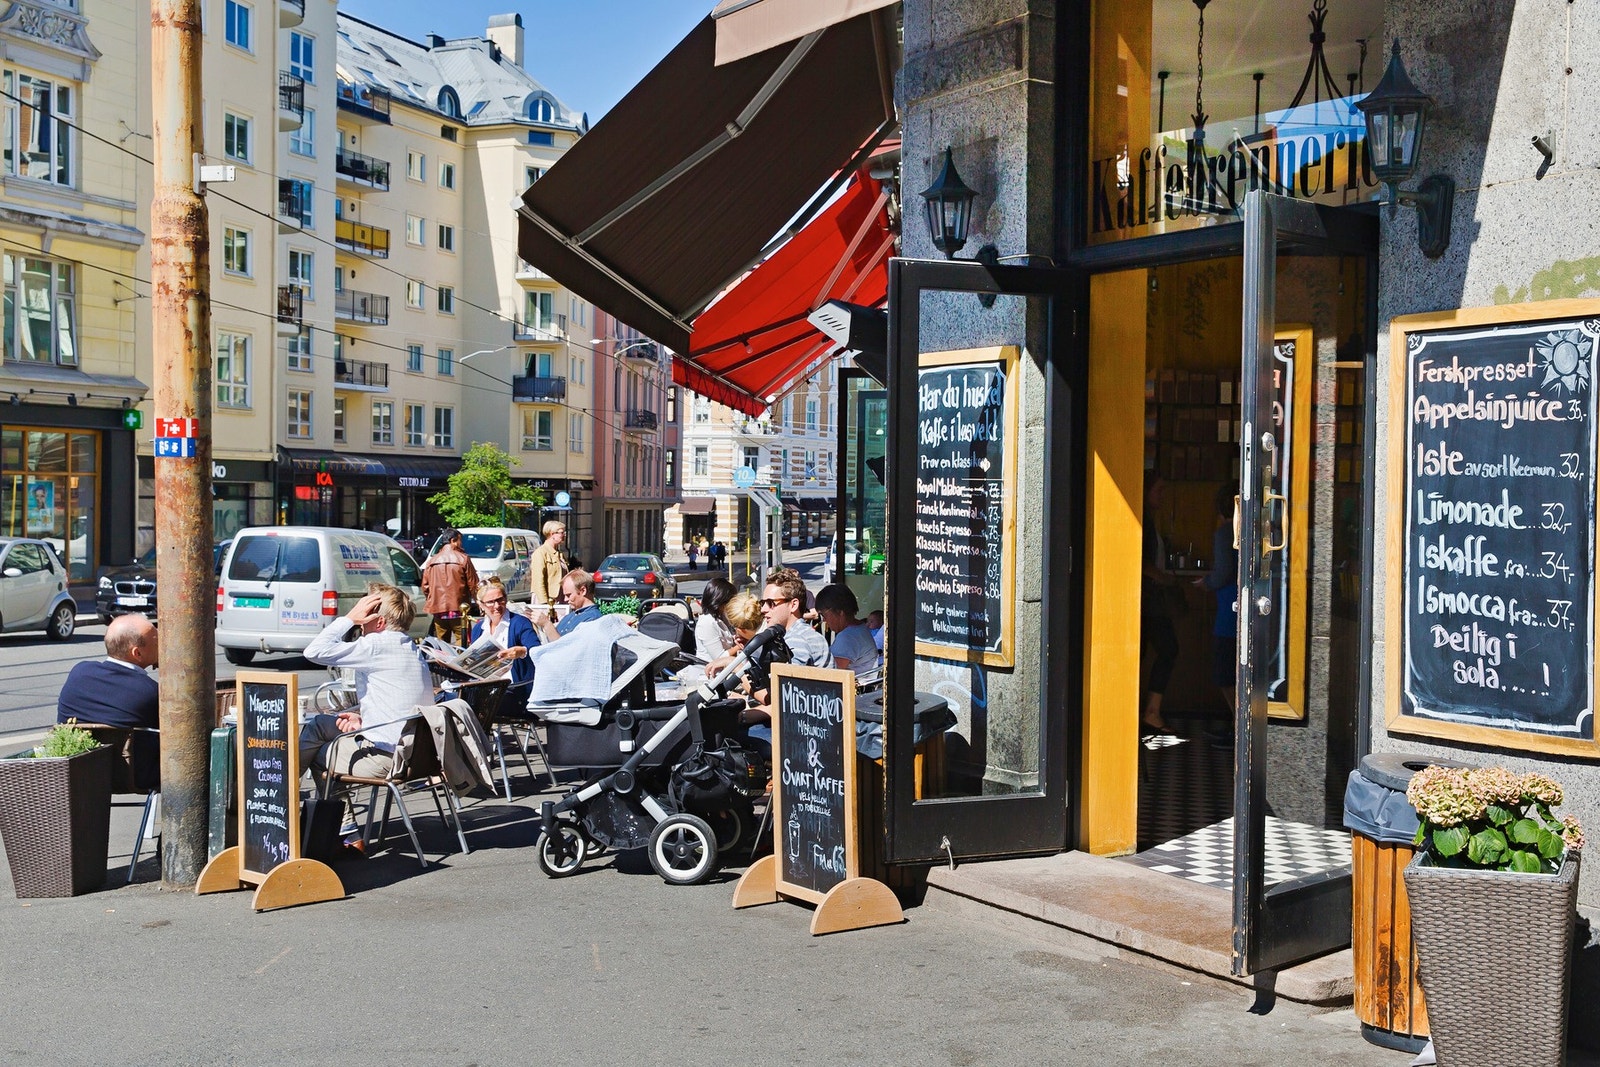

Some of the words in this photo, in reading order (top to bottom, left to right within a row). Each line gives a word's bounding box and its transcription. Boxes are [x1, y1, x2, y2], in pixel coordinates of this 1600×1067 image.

[1418, 347, 1538, 391] Ferskpresset
[918, 383, 942, 412] Har
[943, 374, 960, 409] du
[1414, 389, 1567, 429] Appelsinjuice
[1567, 399, 1587, 422] 35,-
[162, 423, 169, 438] 7
[920, 416, 948, 448] Kaffe
[950, 417, 956, 442] i
[1417, 441, 1464, 478] Iste
[1464, 461, 1482, 477] av
[1482, 455, 1508, 477] sort
[316, 472, 333, 486] ICA
[399, 477, 419, 487] STUDIO
[917, 477, 936, 498] Royal
[916, 500, 939, 517] Fransk
[939, 521, 972, 538] Espresso
[915, 535, 946, 553] Klassisk
[946, 539, 980, 557] Espresso
[1418, 534, 1500, 577] Iskaffe
[934, 556, 960, 576] Mocca
[916, 574, 952, 596] Colombia
[952, 578, 983, 598] Espresso
[920, 602, 934, 614] Noe
[934, 601, 945, 616] for
[1418, 575, 1505, 622] Ismocca
[1430, 621, 1501, 666] Deilig
[1505, 632, 1518, 659] i
[256, 715, 280, 732] KAFFE
[808, 738, 825, 769] &
[813, 767, 845, 797] KAFFE
